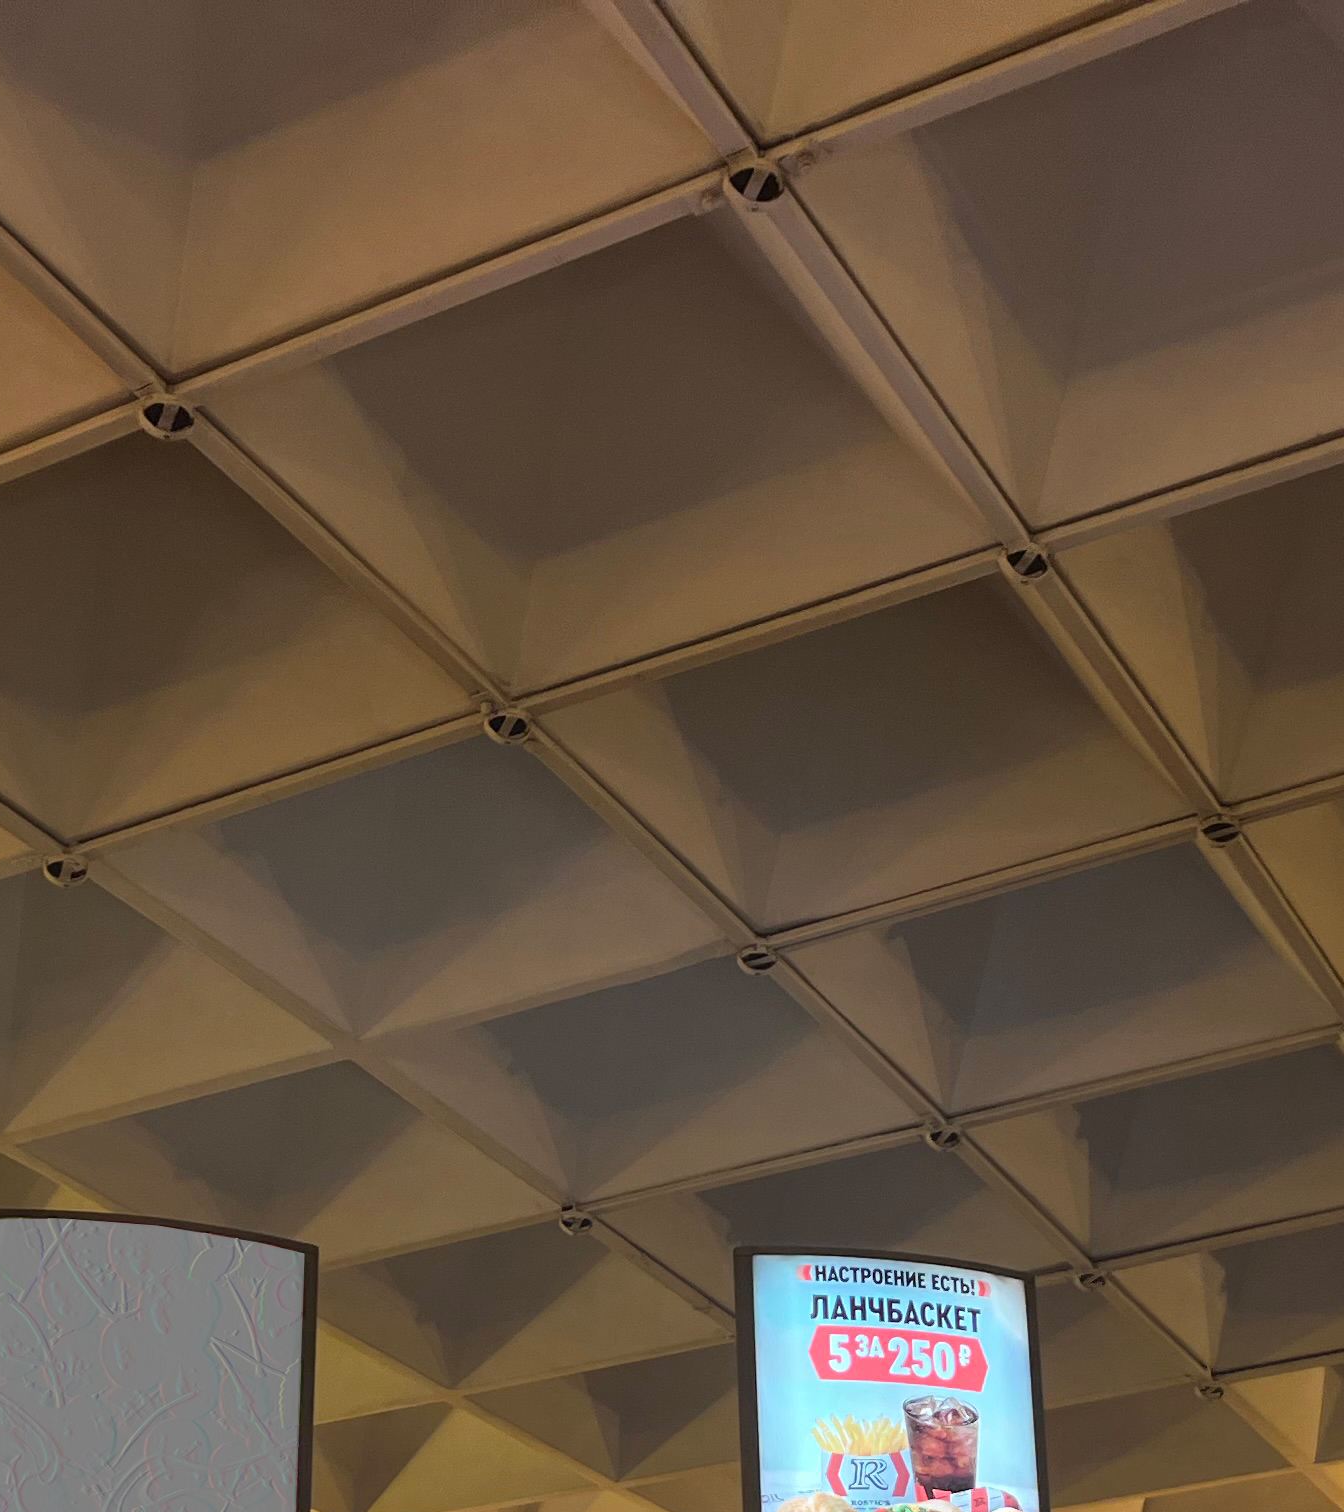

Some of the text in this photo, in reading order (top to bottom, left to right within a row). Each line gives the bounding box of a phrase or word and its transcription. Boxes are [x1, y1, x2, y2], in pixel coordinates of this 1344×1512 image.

[814, 1265, 975, 1295] НАСТРОЕНИЕ ЕСТЬ!
[810, 1294, 981, 1333] ЛАНЧБАСКЕТ
[828, 1333, 852, 1373] 5
[855, 1334, 885, 1358] ЗА
